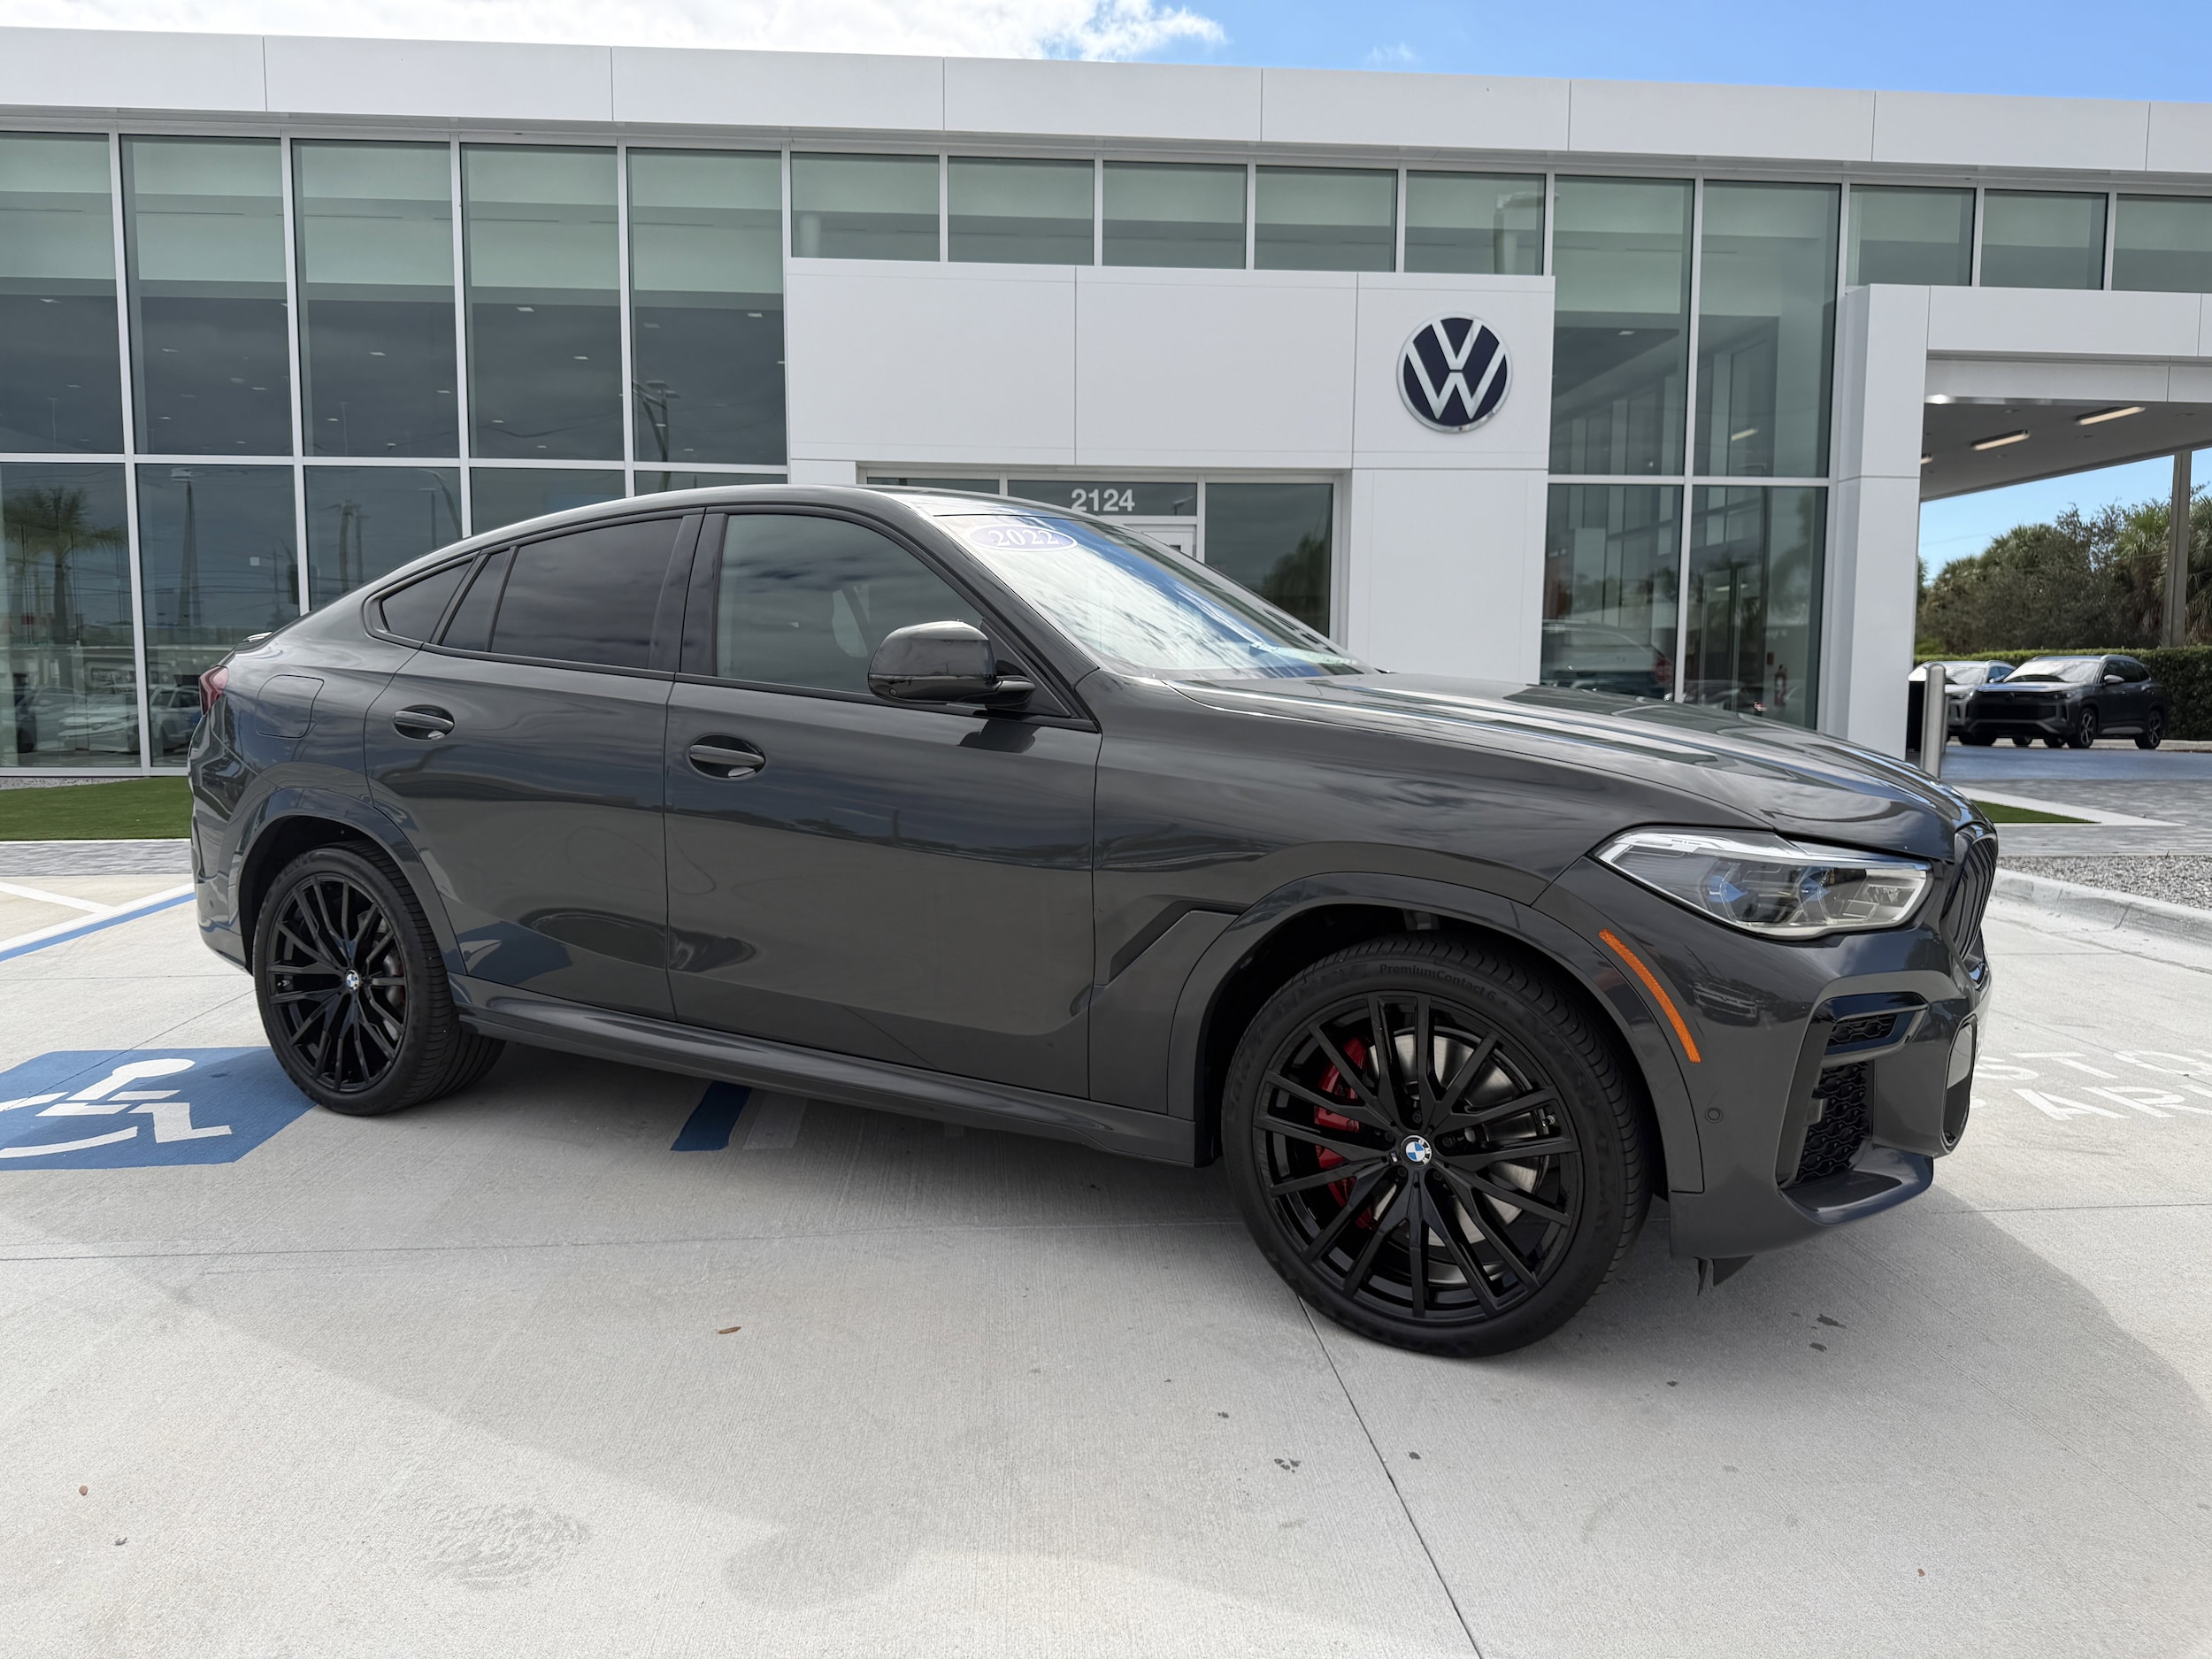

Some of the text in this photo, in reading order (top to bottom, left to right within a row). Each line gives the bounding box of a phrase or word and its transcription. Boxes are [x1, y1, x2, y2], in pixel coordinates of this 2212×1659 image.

[1399, 313, 1509, 425] VW
[1071, 488, 1135, 512] 2124
[987, 529, 1059, 547] 2022
[1379, 963, 1497, 1001] PremiumContact 6
